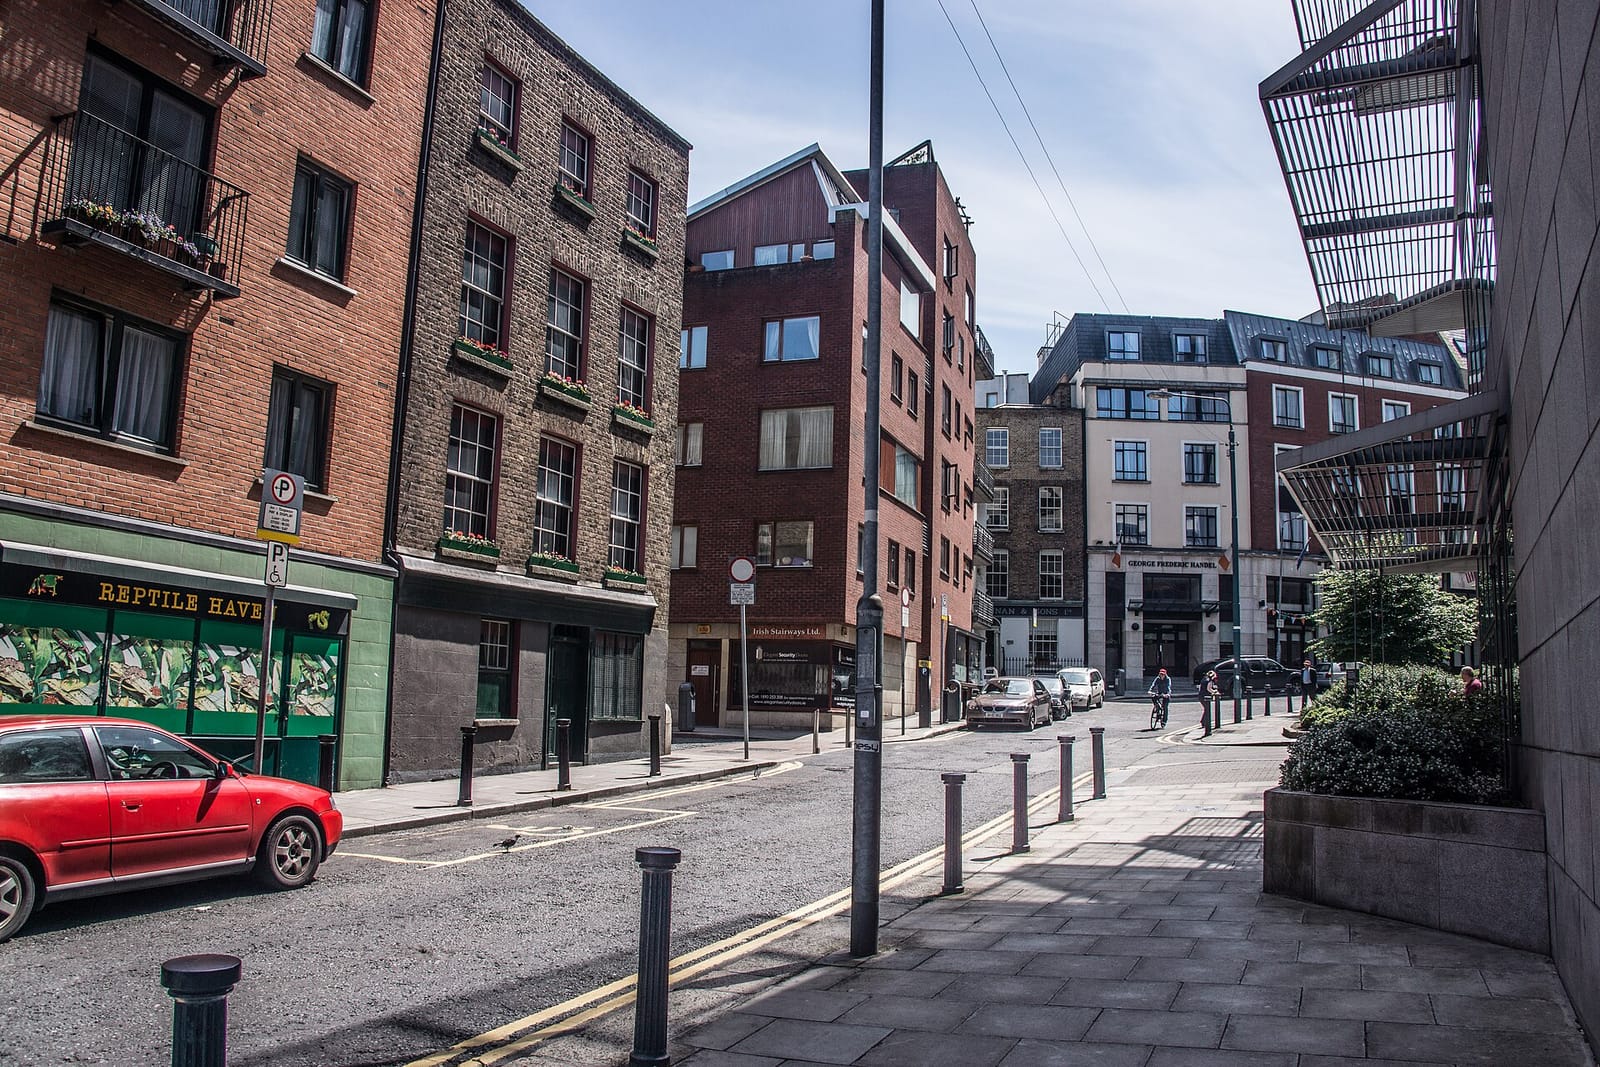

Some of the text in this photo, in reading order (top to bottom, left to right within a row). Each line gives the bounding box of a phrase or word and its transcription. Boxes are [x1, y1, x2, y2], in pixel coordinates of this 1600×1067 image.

[280, 479, 290, 498] P
[273, 543, 283, 562] P
[1128, 560, 1156, 568] GEORGE
[1190, 561, 1217, 569] HANDEL
[98, 582, 199, 612] REPTILE
[753, 627, 821, 637] Irish Stairways Ltd.
